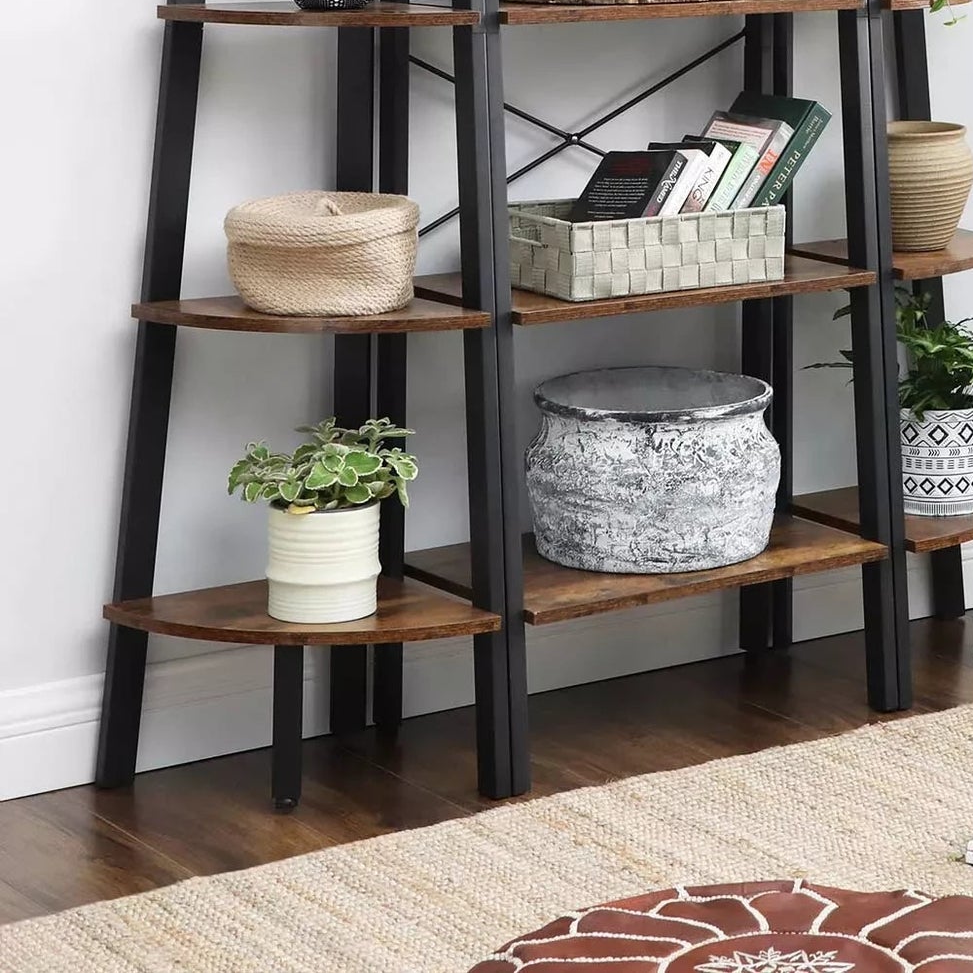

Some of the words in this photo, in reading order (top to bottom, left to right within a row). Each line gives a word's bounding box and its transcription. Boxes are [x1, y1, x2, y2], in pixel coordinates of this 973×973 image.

[669, 159, 683, 176] THE
[692, 166, 714, 200] KING
[772, 150, 801, 190] PETER
